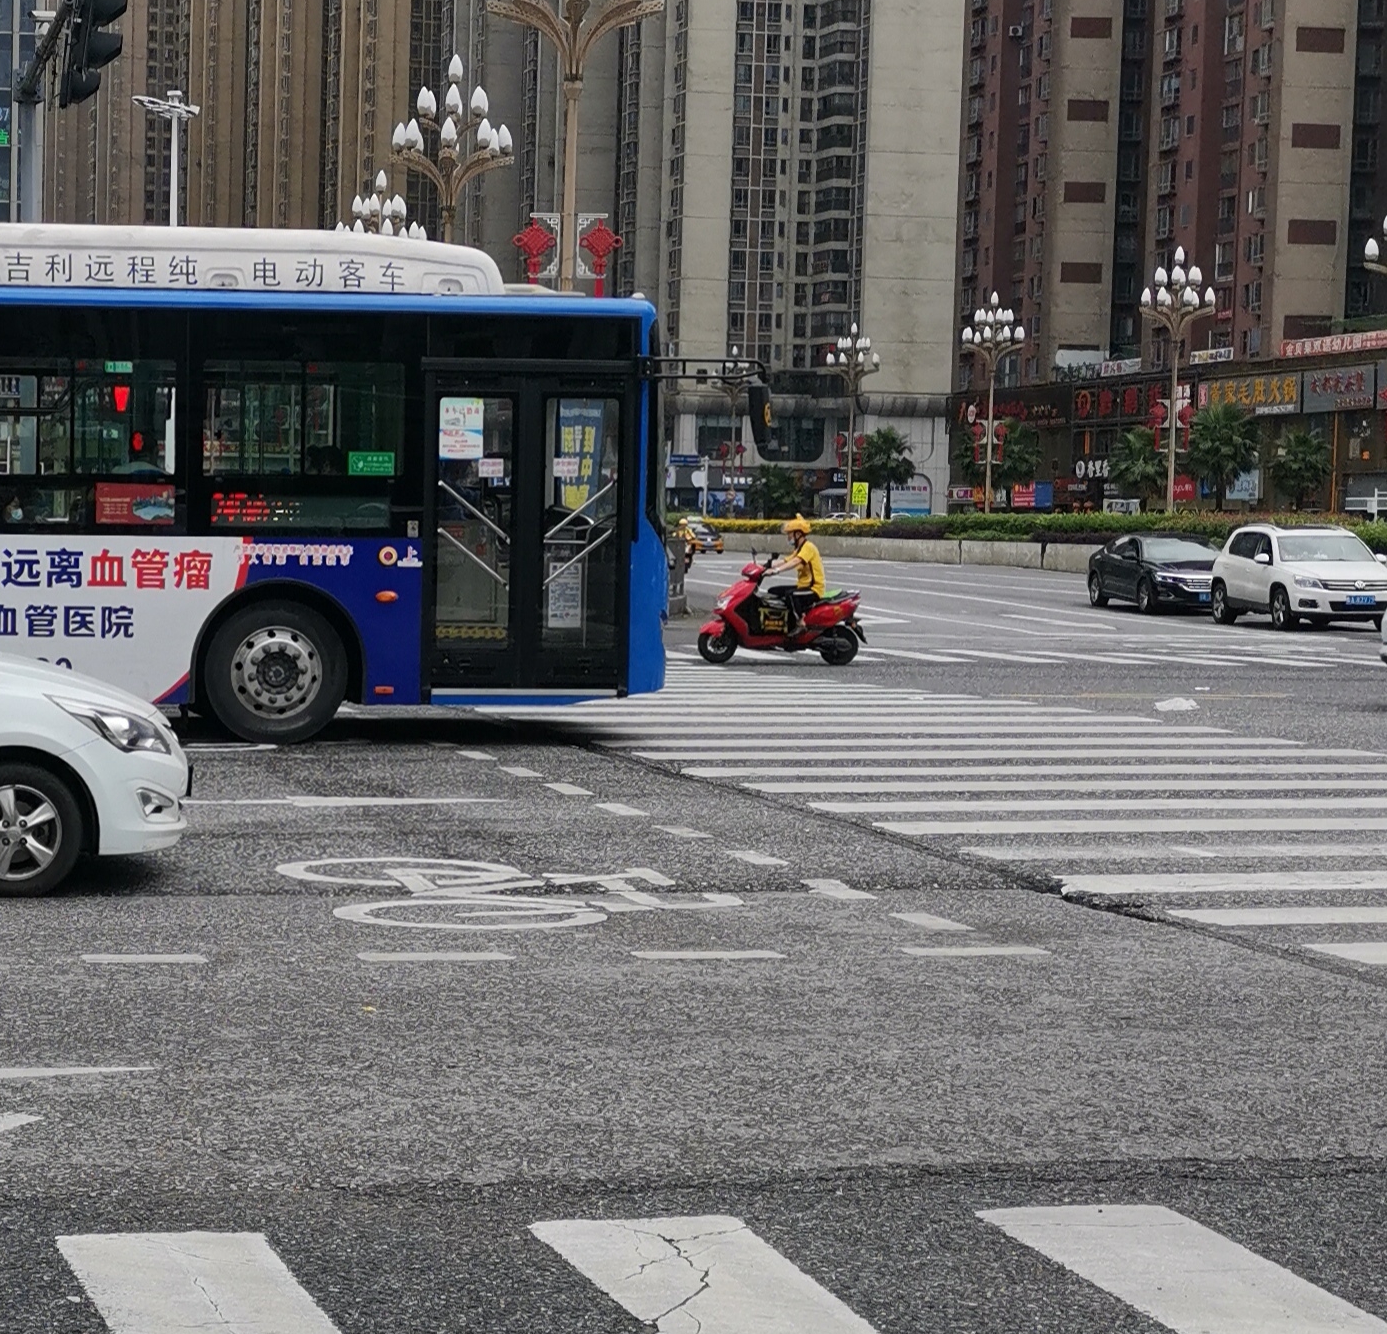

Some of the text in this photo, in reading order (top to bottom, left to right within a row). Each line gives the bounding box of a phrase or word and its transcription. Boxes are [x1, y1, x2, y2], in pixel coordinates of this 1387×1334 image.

[4, 251, 406, 291] 吉利远程纯 电动客车
[1, 547, 213, 591] 远离血管瘤
